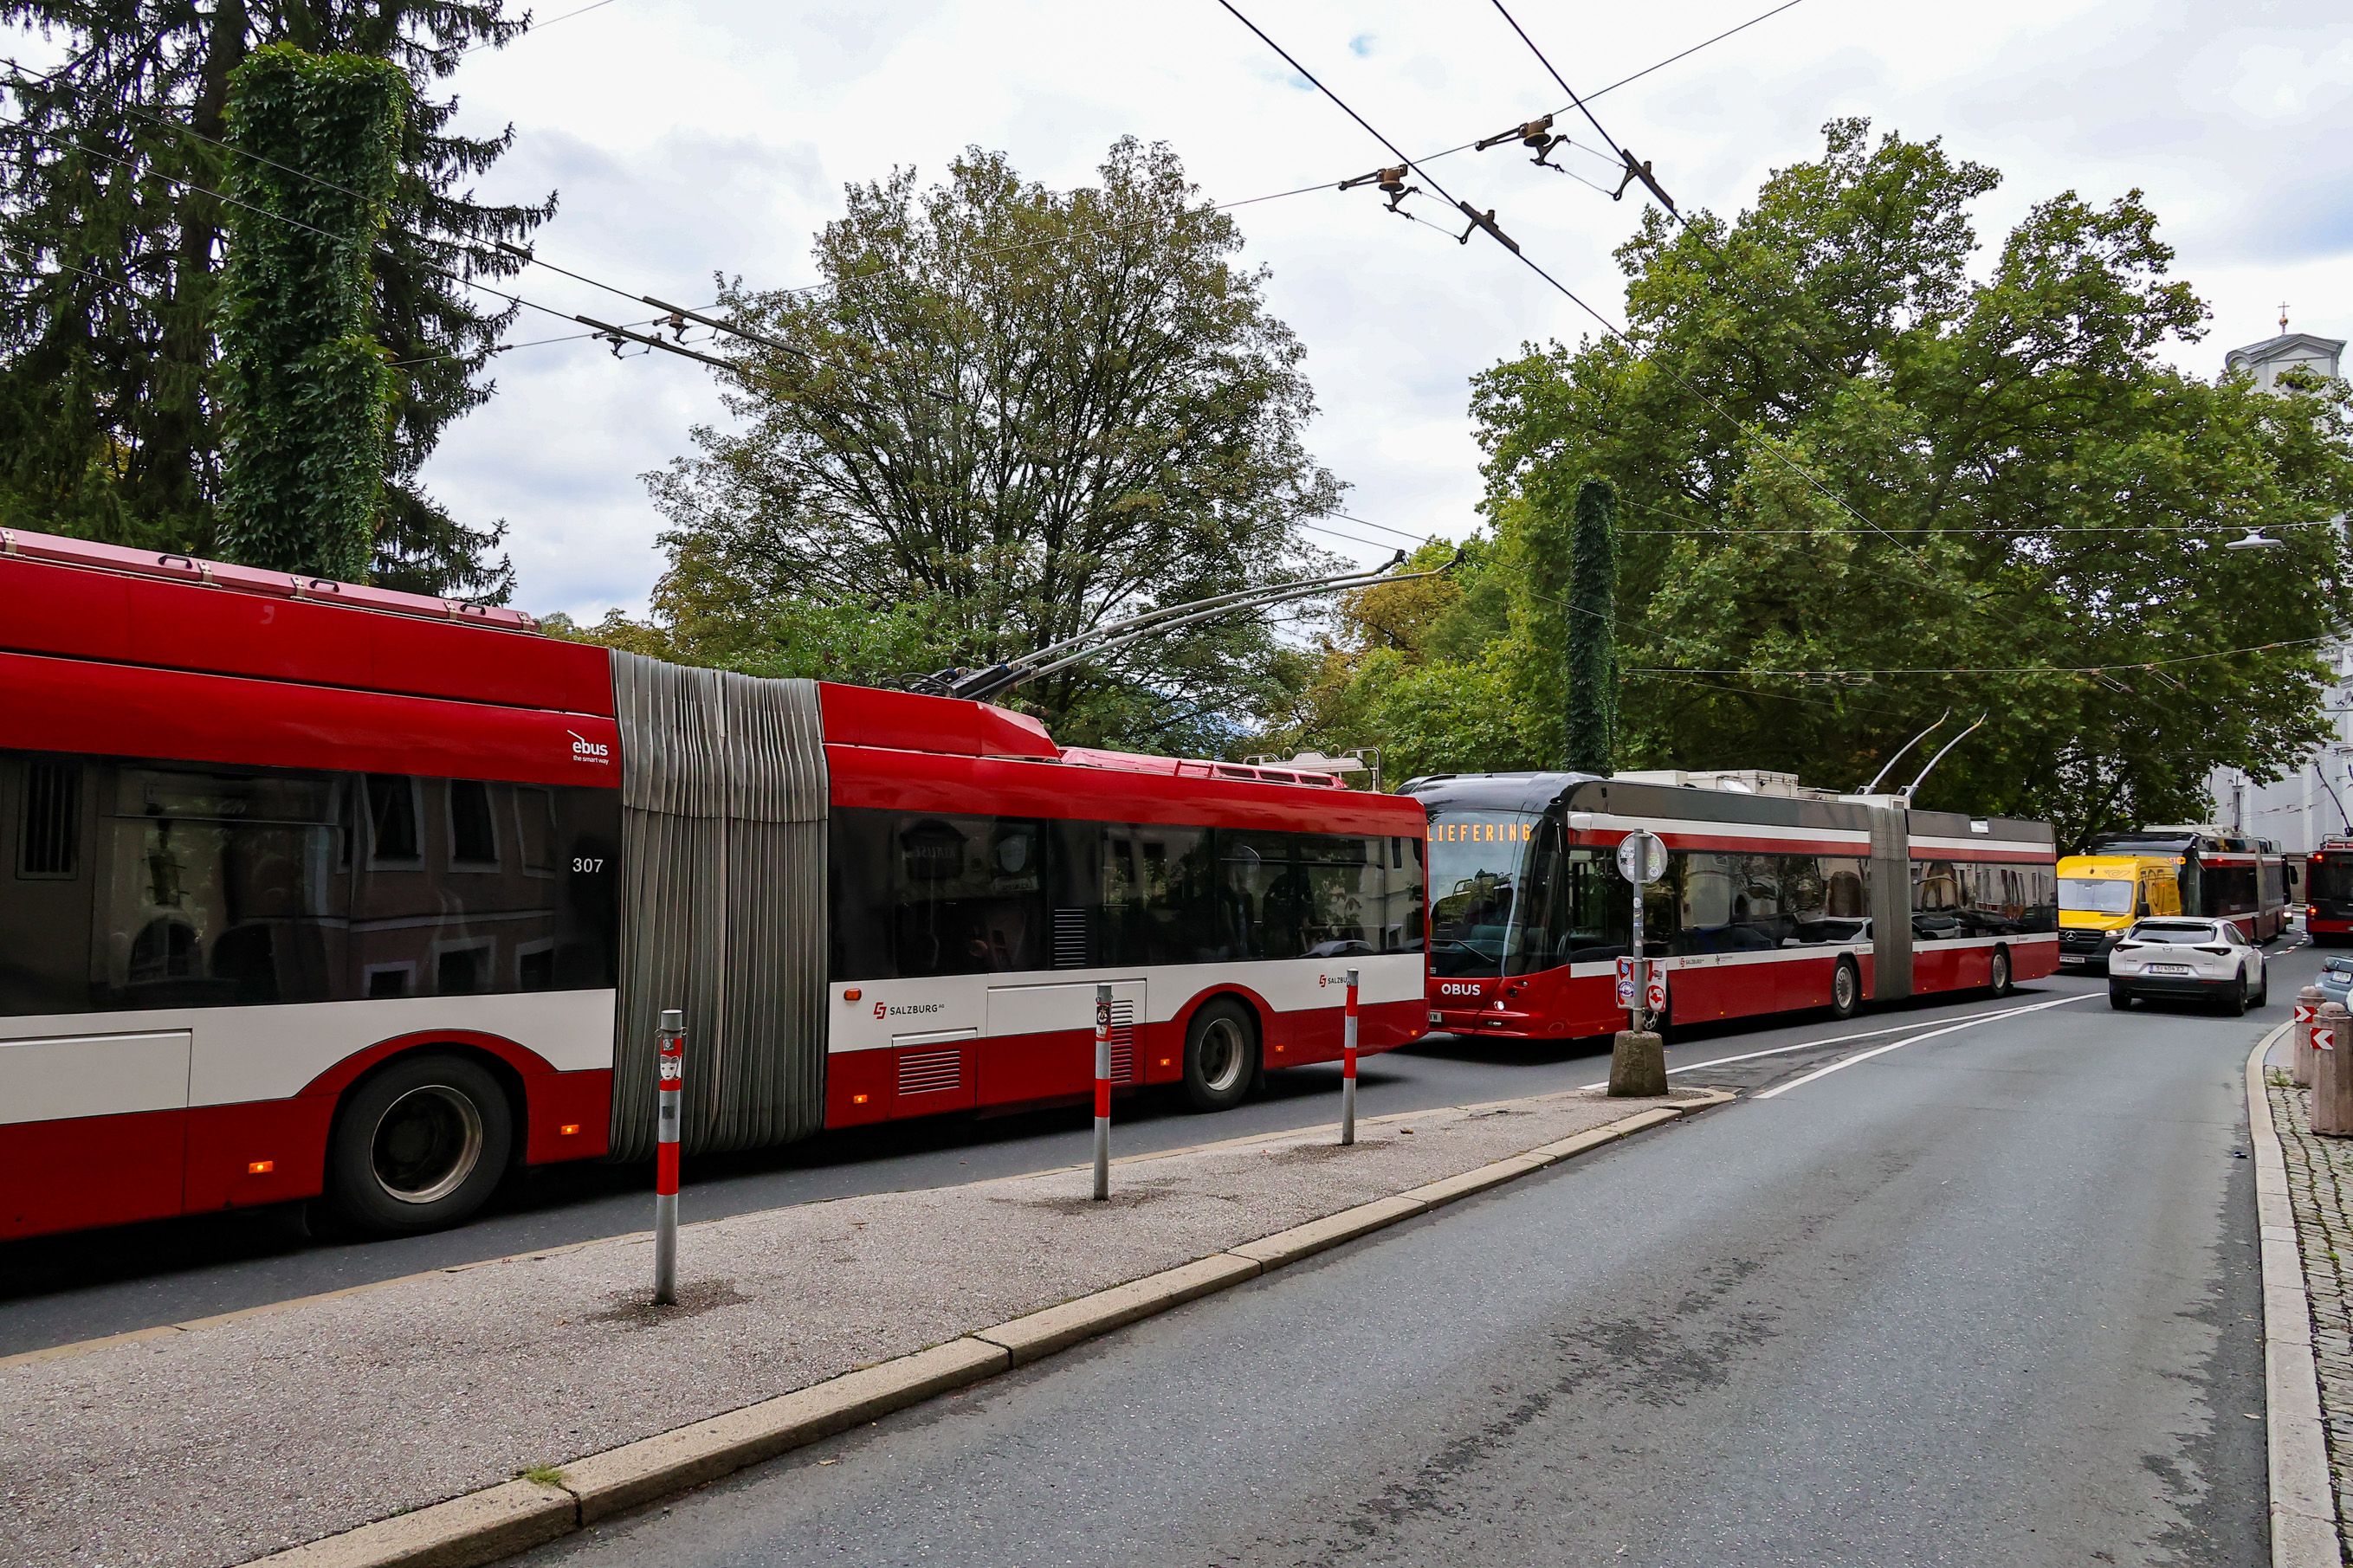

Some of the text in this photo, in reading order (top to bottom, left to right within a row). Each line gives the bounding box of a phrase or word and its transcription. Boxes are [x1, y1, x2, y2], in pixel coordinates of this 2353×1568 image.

[568, 730, 609, 756] ebus
[1427, 823, 1531, 842] LIEFERING
[572, 857, 604, 873] 307
[1441, 983, 1481, 996] OBUS
[889, 1004, 938, 1016] SALZBURG
